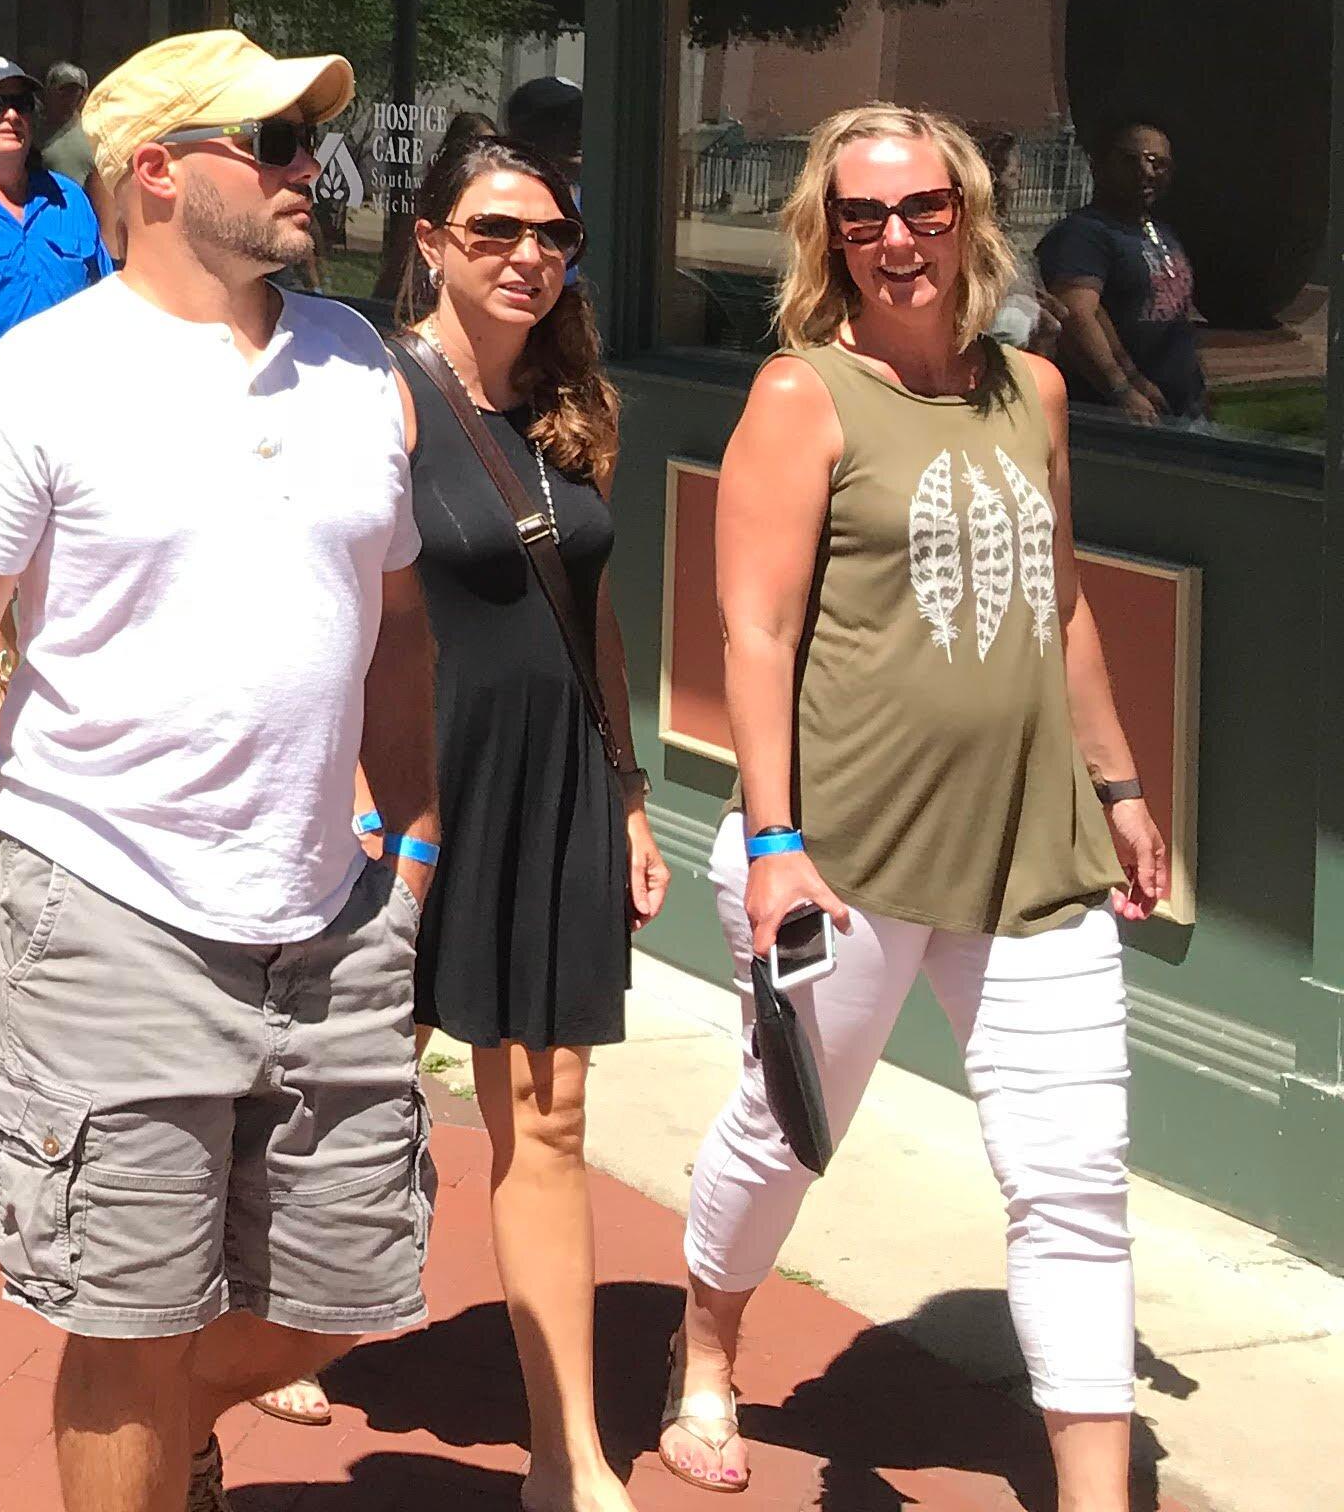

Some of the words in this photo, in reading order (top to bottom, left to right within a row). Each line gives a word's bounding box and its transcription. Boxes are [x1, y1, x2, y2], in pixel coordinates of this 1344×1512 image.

[373, 102, 447, 132] HOSPICE
[372, 135, 424, 165] CARE
[372, 167, 422, 189] Southw
[372, 193, 415, 215] Michi
